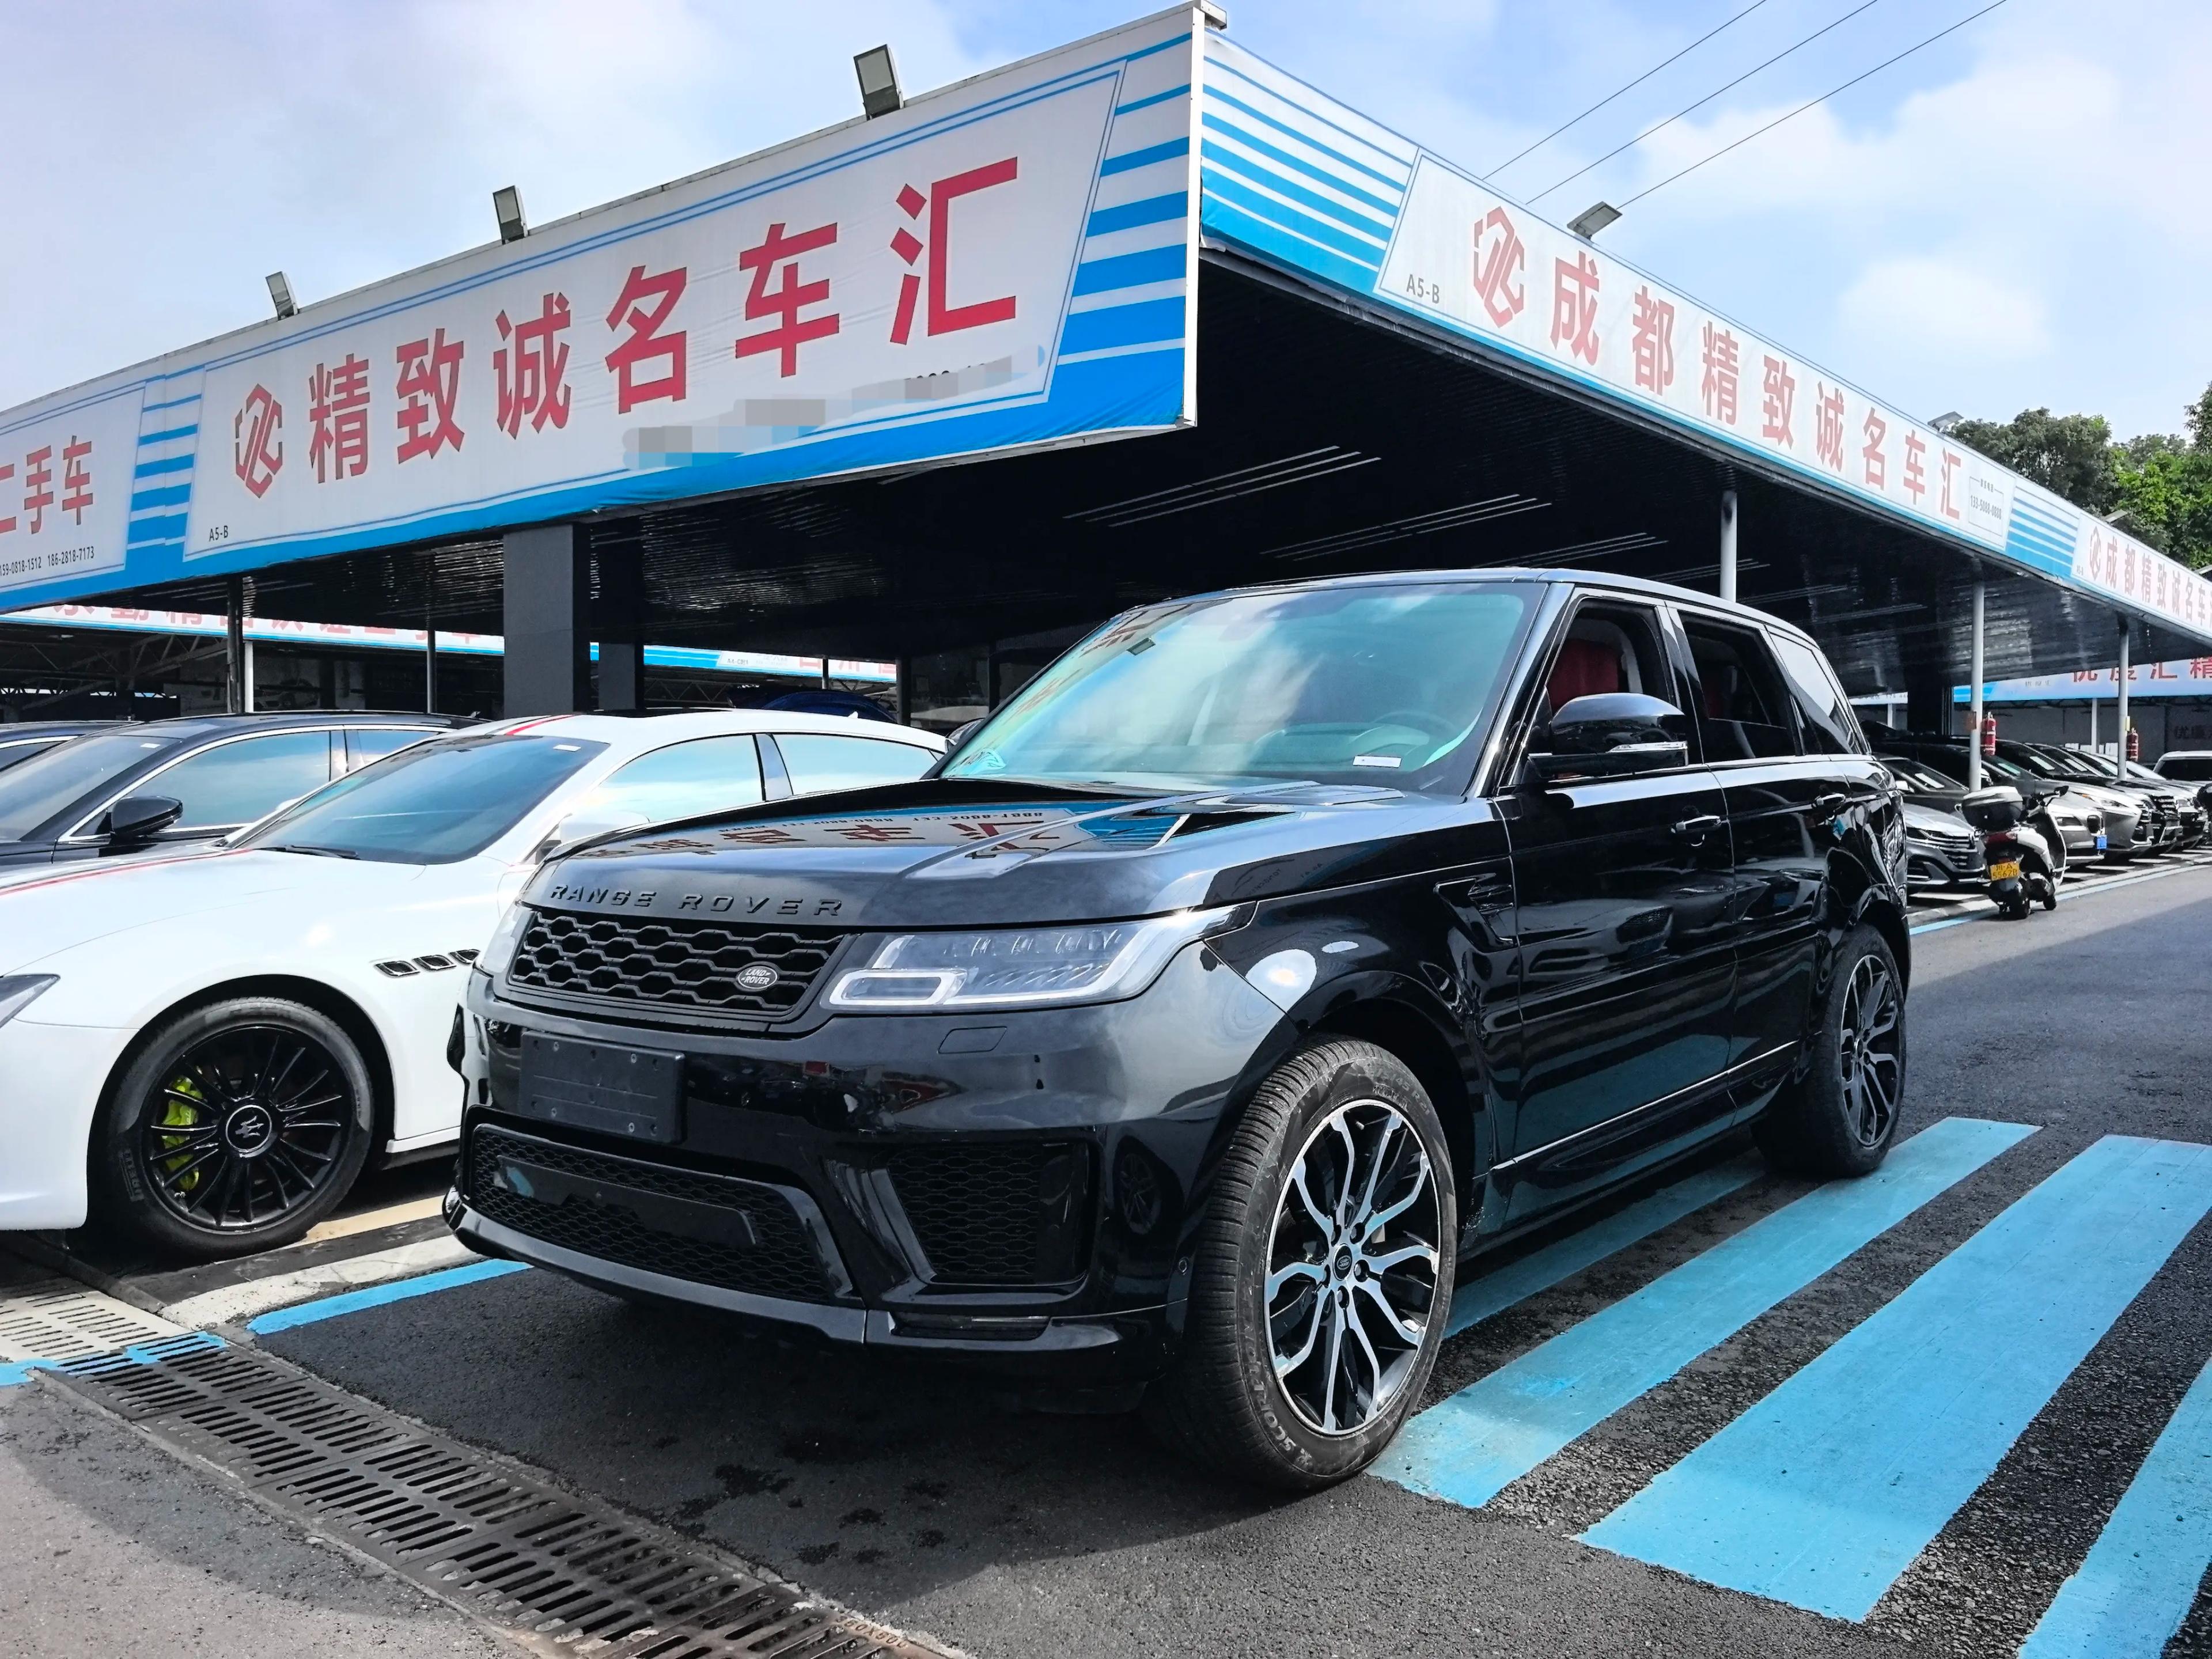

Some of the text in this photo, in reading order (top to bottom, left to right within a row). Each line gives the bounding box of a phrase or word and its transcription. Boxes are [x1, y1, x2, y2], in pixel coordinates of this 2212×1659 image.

[1406, 274, 1440, 304] A5-B
[309, 156, 1017, 483] 精致诚名车汇
[1550, 250, 1961, 521] 成都精致诚名车汇
[209, 525, 229, 542] A5-B
[47, 546, 94, 566] 186-2818-7173
[2105, 536, 2212, 628] 成都精致诚名车
[550, 884, 843, 916] RANGE ROVER
[744, 976, 770, 985] ROVER
[745, 968, 767, 977] LAND
